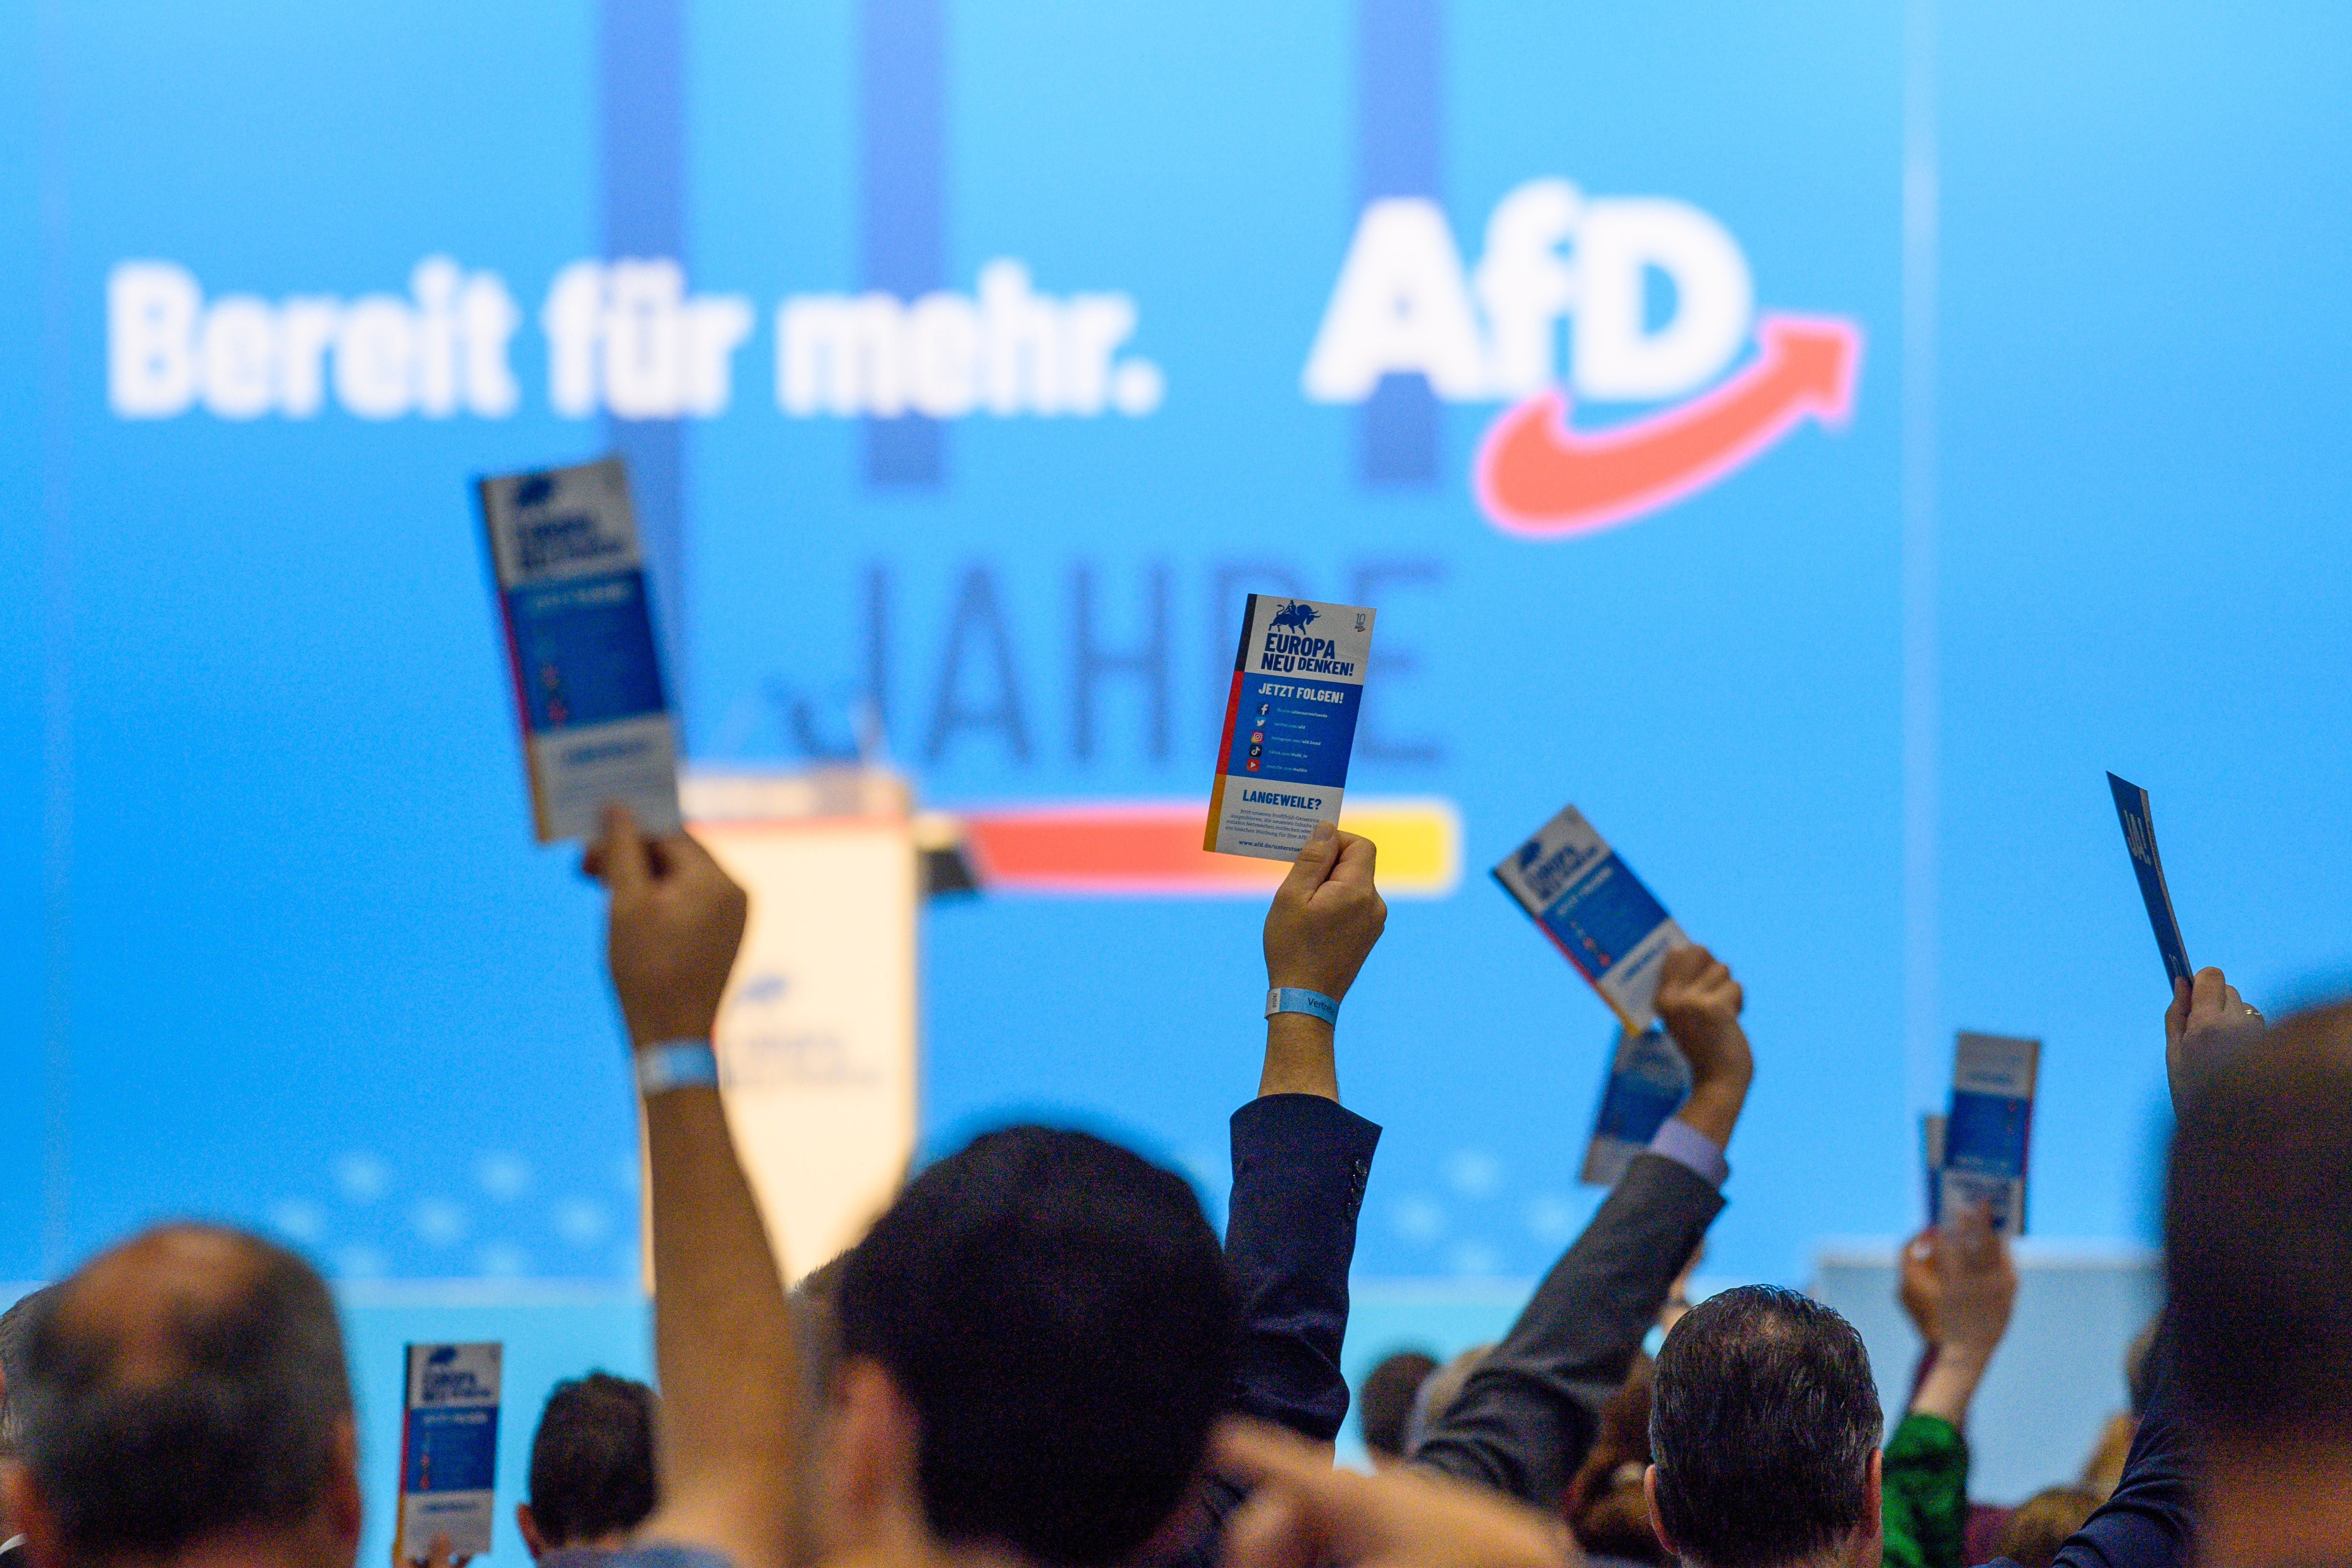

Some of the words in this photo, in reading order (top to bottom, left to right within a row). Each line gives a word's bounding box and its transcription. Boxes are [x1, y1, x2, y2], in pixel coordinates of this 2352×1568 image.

[1301, 179, 1753, 401] AfD
[109, 255, 520, 419] Bereit
[545, 257, 751, 418] für
[775, 257, 1165, 417] mehr.
[1265, 633, 1335, 659] EUROPA
[1260, 653, 1296, 672] NEU
[1297, 657, 1354, 676] DENKEN!
[1258, 683, 1295, 697] JETZT
[1296, 687, 1344, 704] FOLGEN!
[1243, 789, 1322, 810] LANGEWEILE?
[1256, 829, 1277, 837] Werbung
[1275, 825, 1300, 833] entdecken
